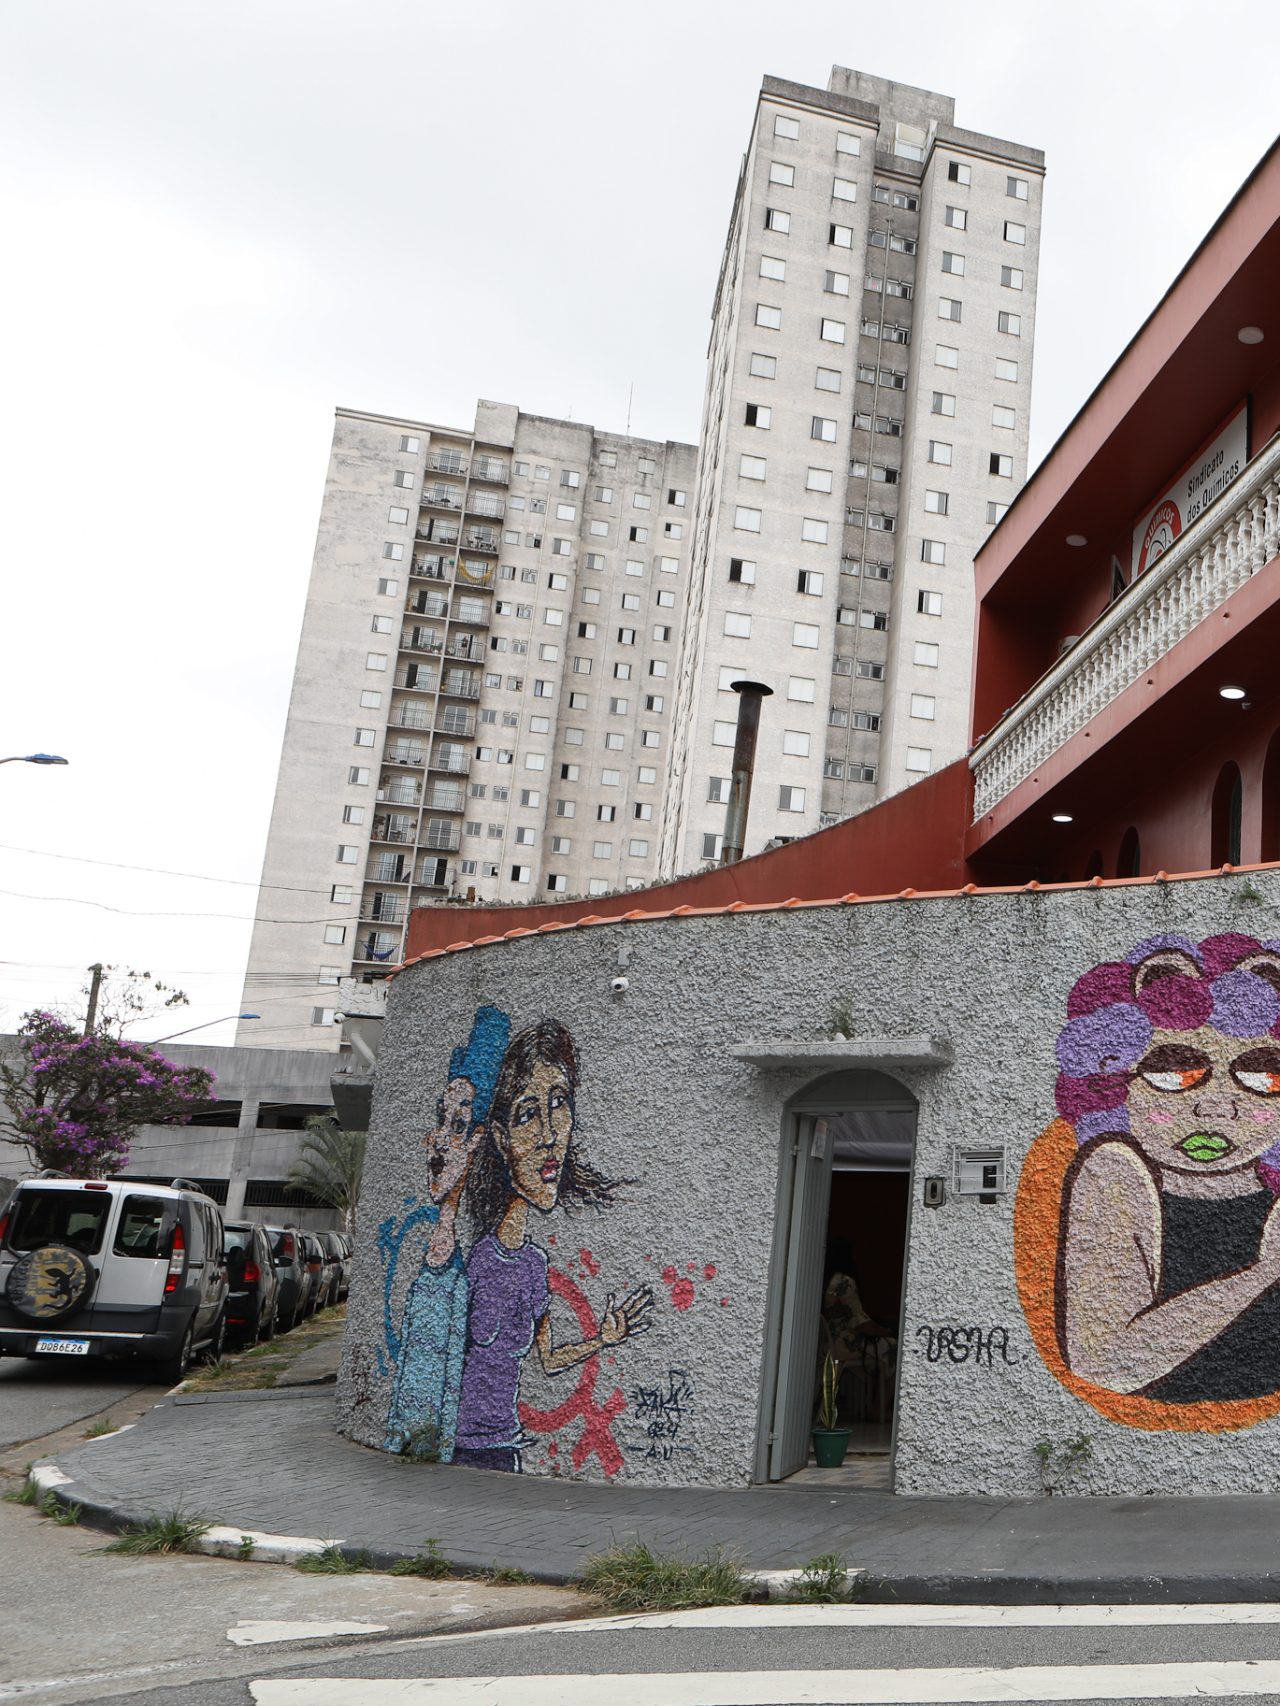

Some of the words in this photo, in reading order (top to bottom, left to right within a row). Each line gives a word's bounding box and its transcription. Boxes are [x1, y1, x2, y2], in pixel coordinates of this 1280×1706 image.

[1188, 450, 1224, 498] Sindicato
[1188, 499, 1200, 523] dos
[40, 1342, 84, 1353] DQB6E26
